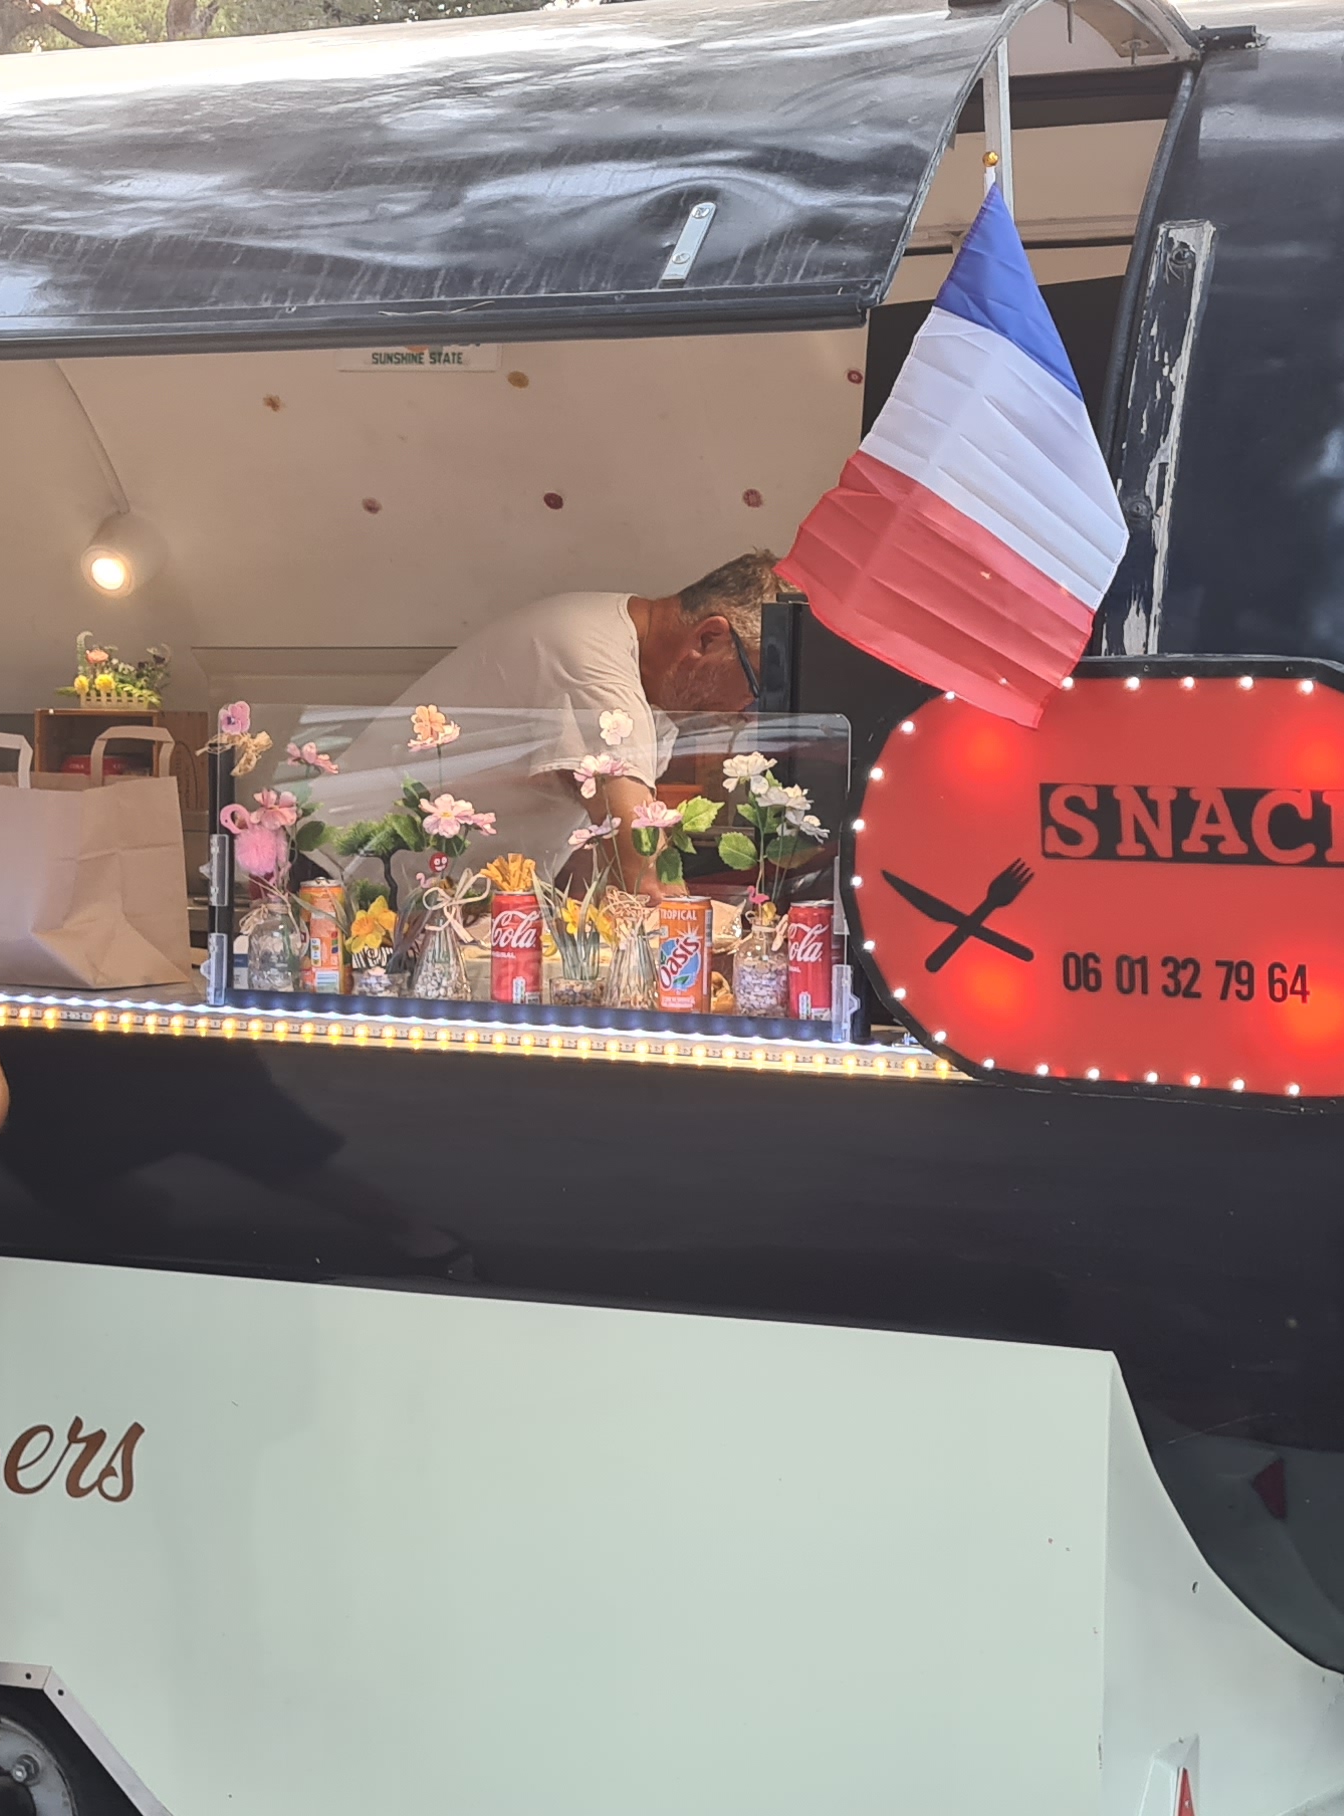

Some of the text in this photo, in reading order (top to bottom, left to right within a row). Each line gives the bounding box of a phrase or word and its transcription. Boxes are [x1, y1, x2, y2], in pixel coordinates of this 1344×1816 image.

[371, 352, 463, 365] SUNSHINE STATE
[660, 936, 700, 991] Oasis
[1063, 951, 1310, 1004] 06 01 32 79 64
